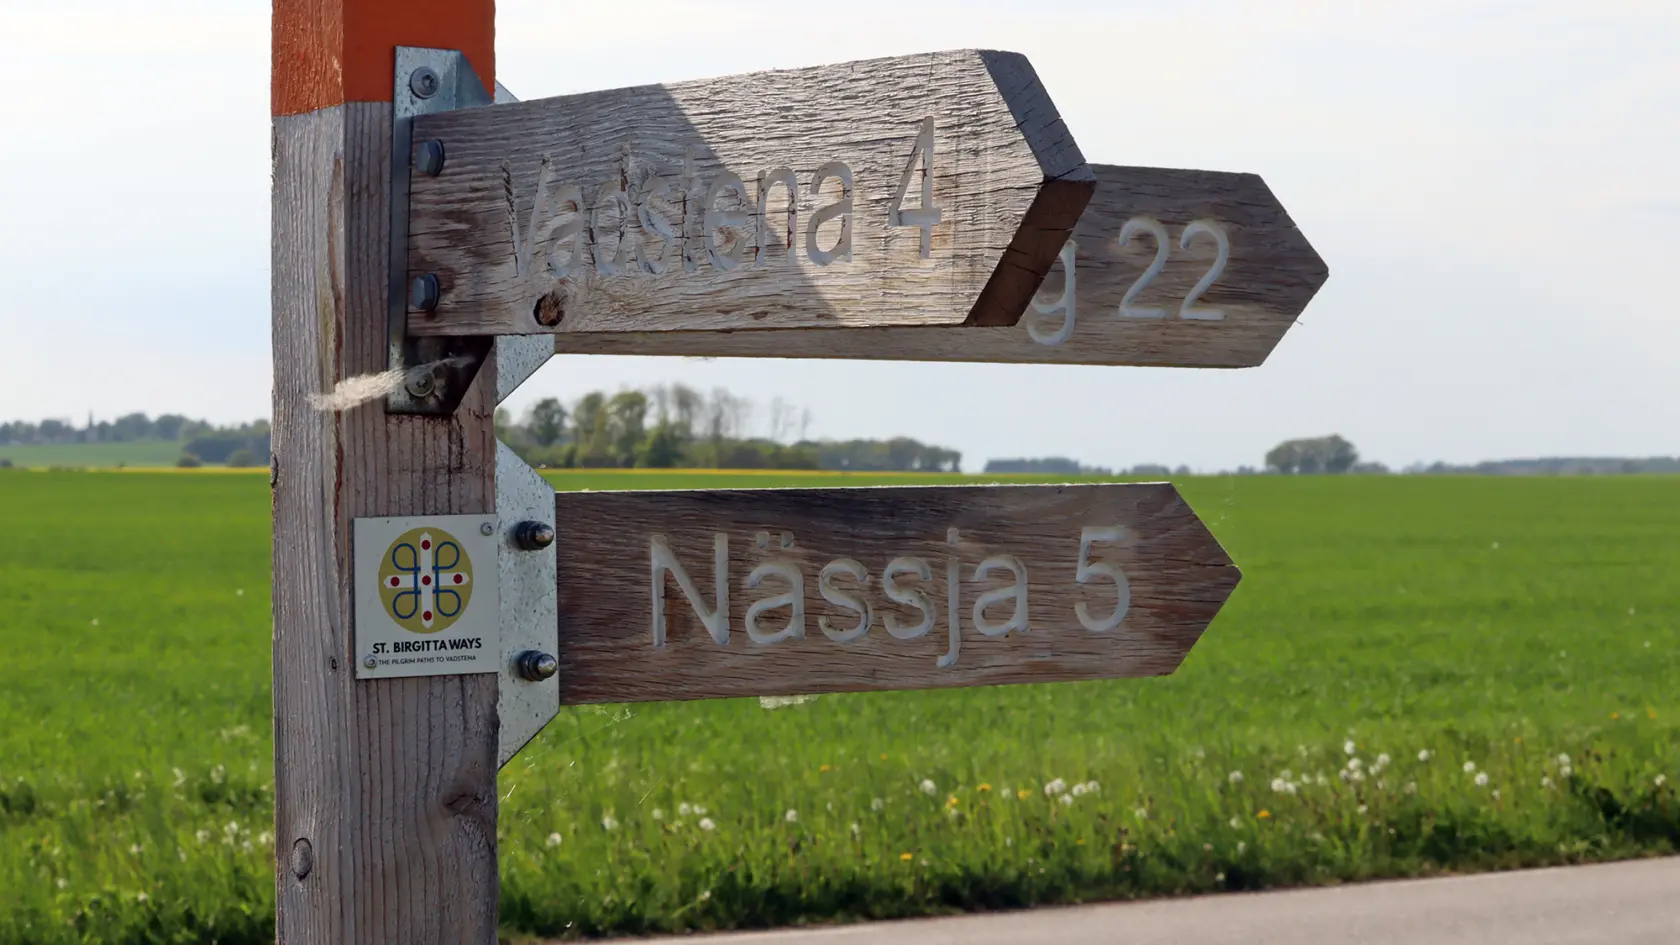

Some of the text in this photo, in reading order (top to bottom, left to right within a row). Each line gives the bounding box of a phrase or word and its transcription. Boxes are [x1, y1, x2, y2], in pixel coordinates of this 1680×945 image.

[500, 115, 942, 279] Vadstena 4
[1117, 216, 1229, 321] 22
[372, 637, 482, 654] ST. BIRGITTA WAYS
[650, 526, 1132, 668] Nässja 5
[446, 654, 477, 662] VADSTENA
